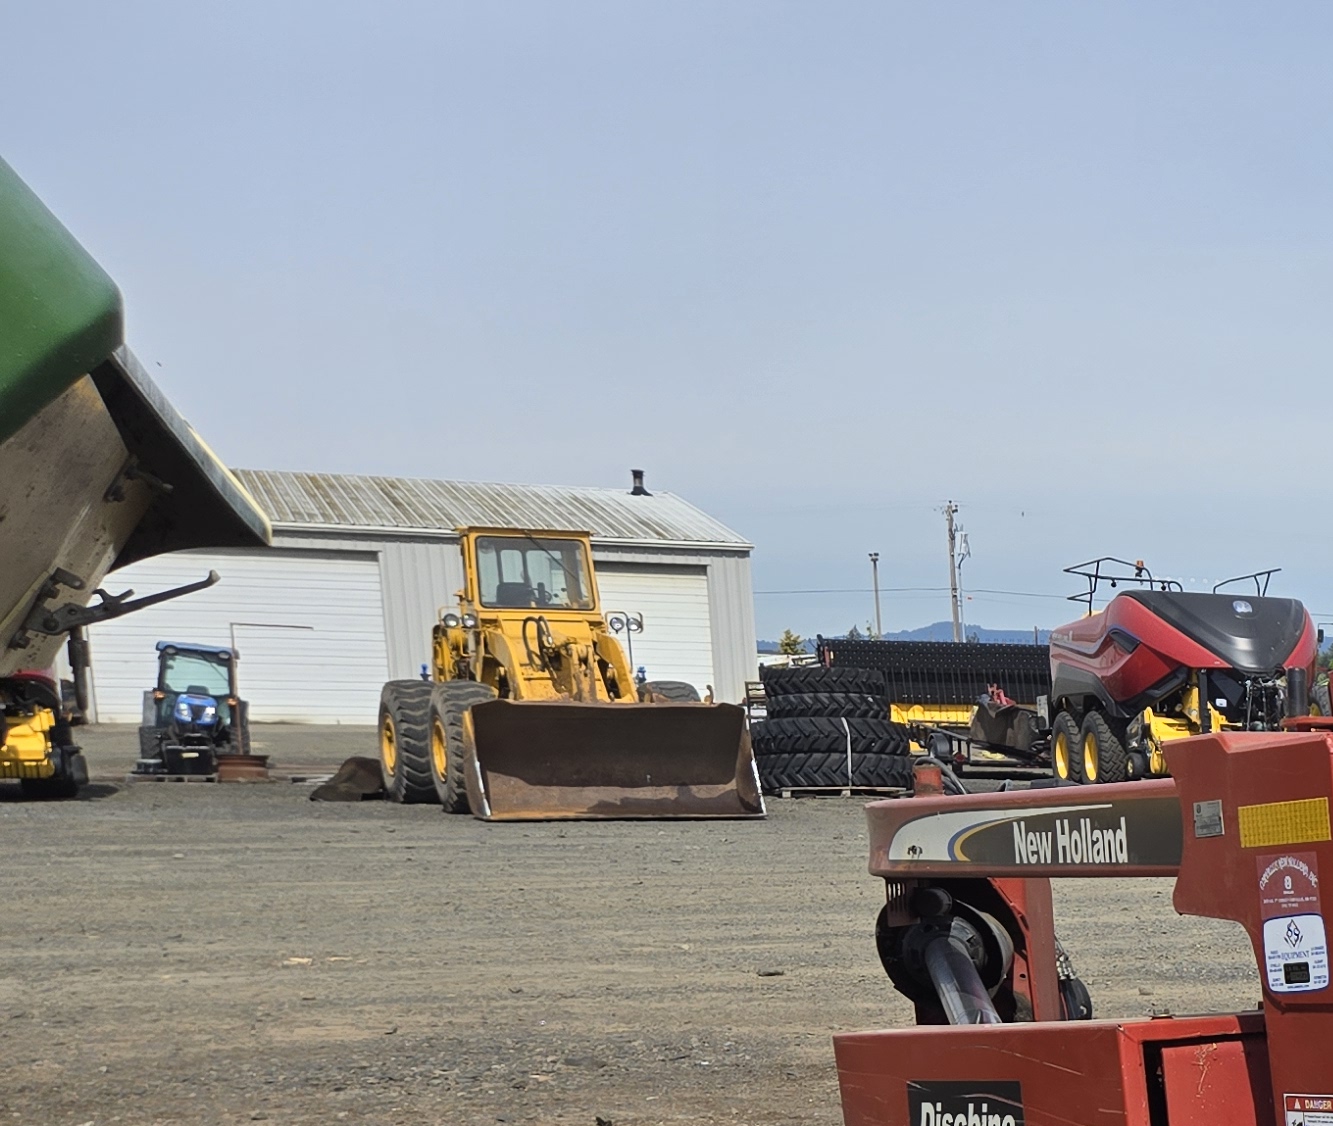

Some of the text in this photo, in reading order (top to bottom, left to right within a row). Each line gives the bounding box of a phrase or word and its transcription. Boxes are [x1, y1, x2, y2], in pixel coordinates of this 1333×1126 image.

[1013, 816, 1128, 864] New Holland
[1281, 950, 1310, 961] EQUIPMENT
[1304, 1099, 1333, 1110] DANGER
